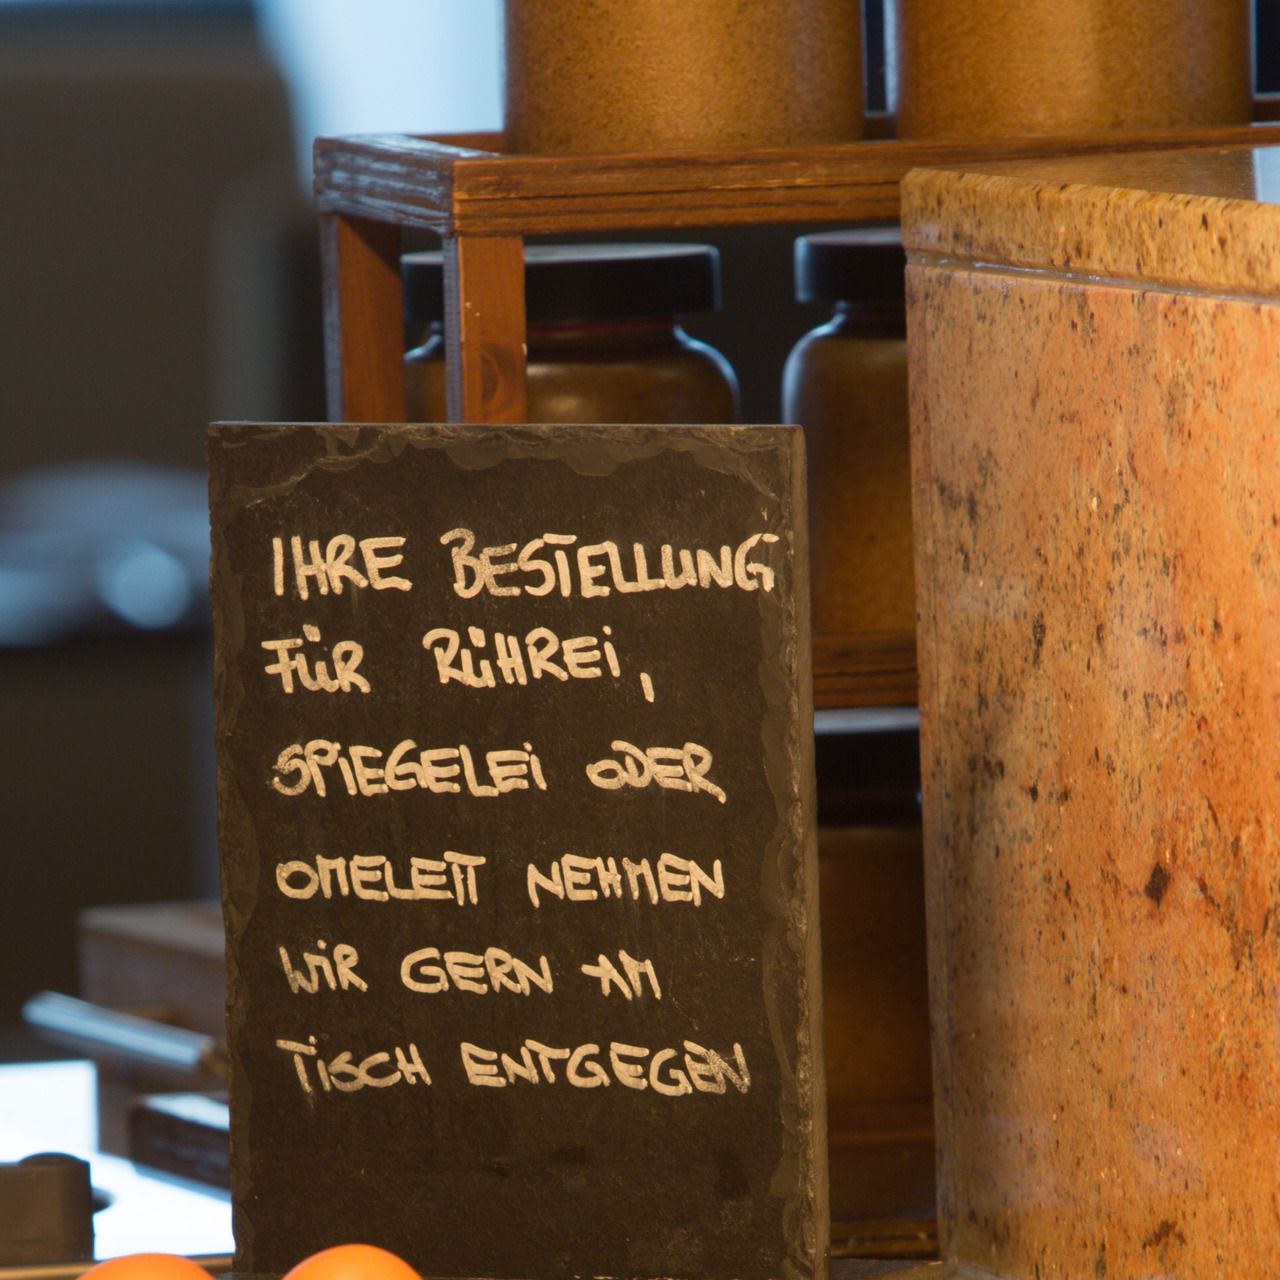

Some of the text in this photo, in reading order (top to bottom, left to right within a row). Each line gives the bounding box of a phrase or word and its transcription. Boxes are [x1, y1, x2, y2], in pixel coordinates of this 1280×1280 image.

[272, 527, 781, 600] IHRE BESTELLUNG
[275, 850, 725, 909] OMELETT NEHMEN
[400, 946, 554, 996] GERN
[580, 949, 662, 1001] AM
[460, 1038, 752, 1096] ENTGEGEN
